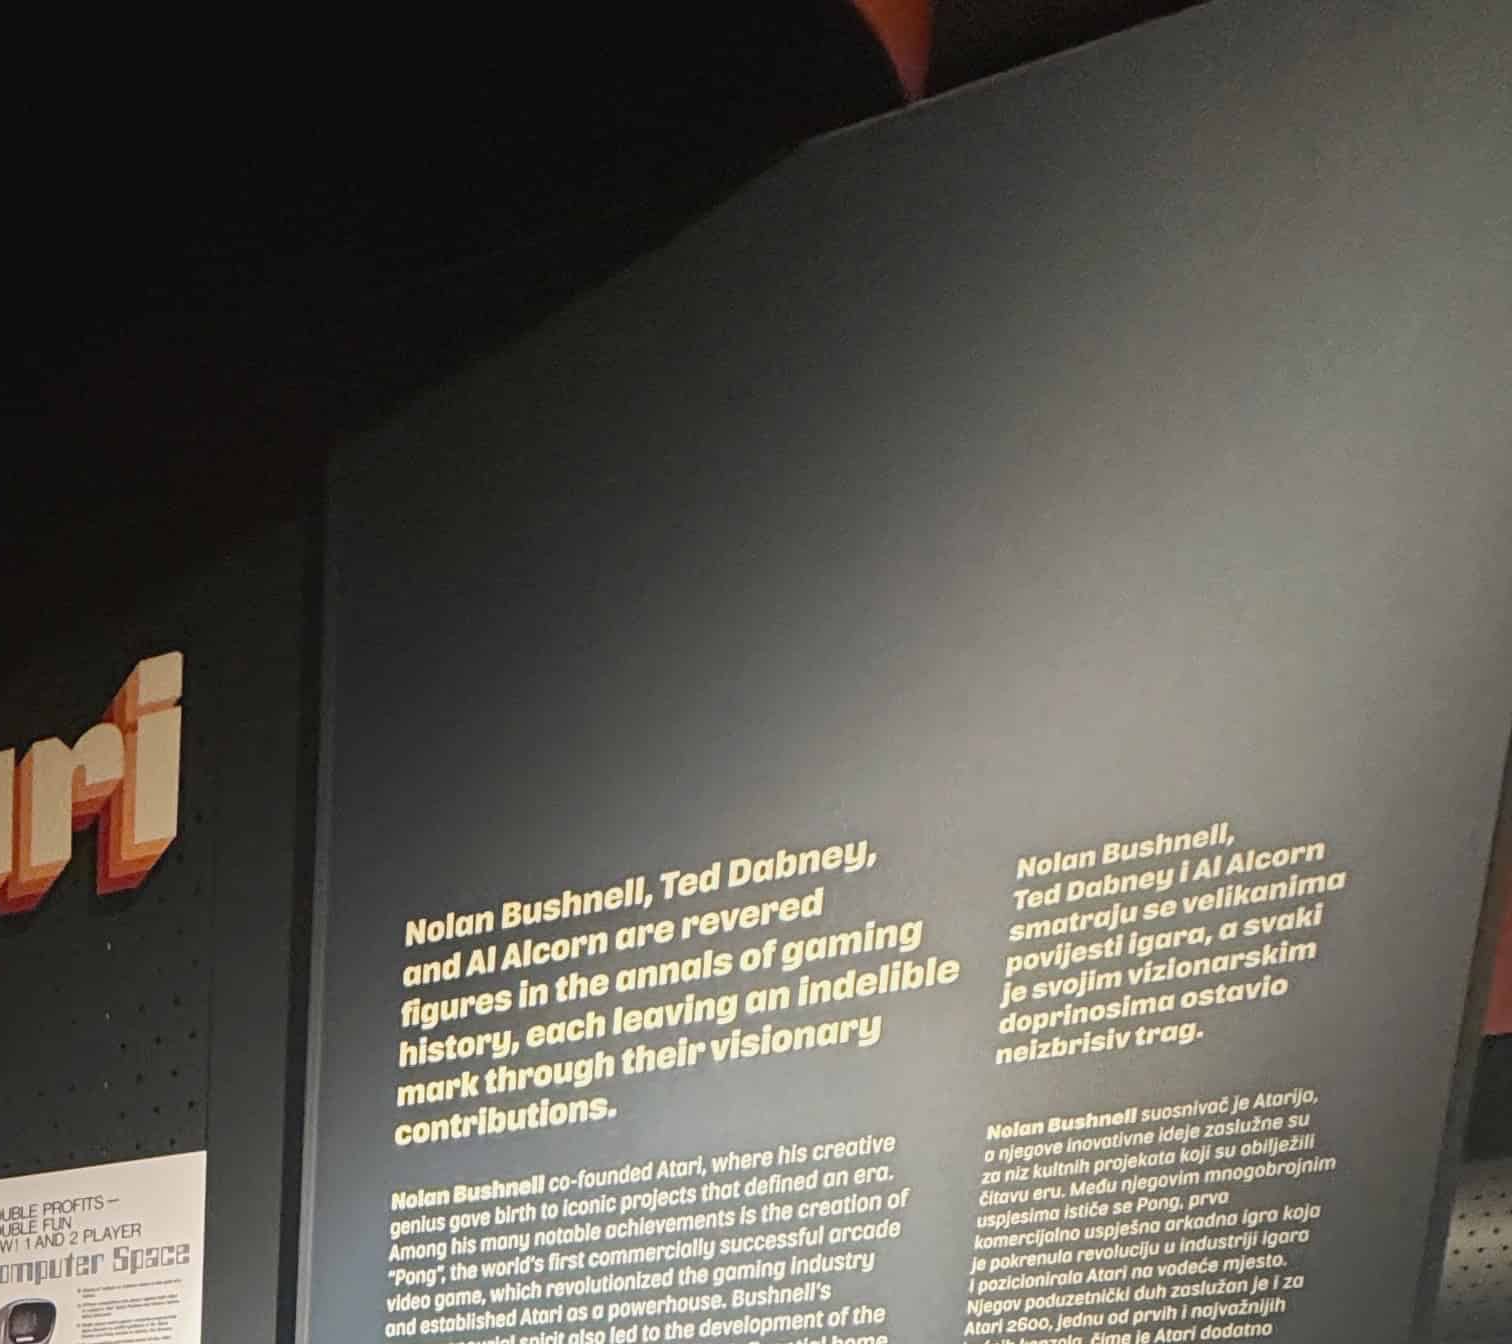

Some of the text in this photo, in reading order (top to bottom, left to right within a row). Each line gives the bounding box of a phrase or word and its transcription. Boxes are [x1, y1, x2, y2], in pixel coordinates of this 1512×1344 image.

[1013, 882, 1061, 910] Ted
[1065, 867, 1174, 901] Dabney
[1191, 856, 1222, 880] Al
[1224, 842, 1325, 875] Alcorn
[1016, 823, 1234, 879] Nolan Bushnell,
[404, 840, 876, 947] Nolan Bushnell, Ted Dabney,
[1008, 871, 1346, 941] smatraju se velikanima
[402, 886, 824, 987] and Al Alcorn are revered
[1005, 933, 1123, 977] povijesti
[1127, 926, 1212, 957] igara,
[1242, 901, 1323, 936] svaki
[400, 920, 922, 1030] figures in the annals of gaming
[998, 976, 1288, 1034] doprinosima ostavio
[999, 939, 1317, 1008] je svojim vizionarskim
[398, 956, 959, 1068] history, each leaving an indelible
[995, 1022, 1203, 1065] neizbrisiv trag.
[396, 1015, 881, 1107] mark through their visionary
[394, 1097, 616, 1146] contributions.
[43, 1196, 105, 1217] PROFITS
[389, 1165, 893, 1240] genius gave birth to iconic projects that defined an era.
[390, 1134, 895, 1211] Nolan Bushnell co-founded Atari, where his creative
[25, 1236, 30, 1249] 1
[33, 1232, 65, 1249] AND
[68, 1231, 78, 1245] 2
[82, 1223, 143, 1242] PLAYER
[43, 1216, 72, 1232] FUN
[112, 1242, 190, 1274] Space
